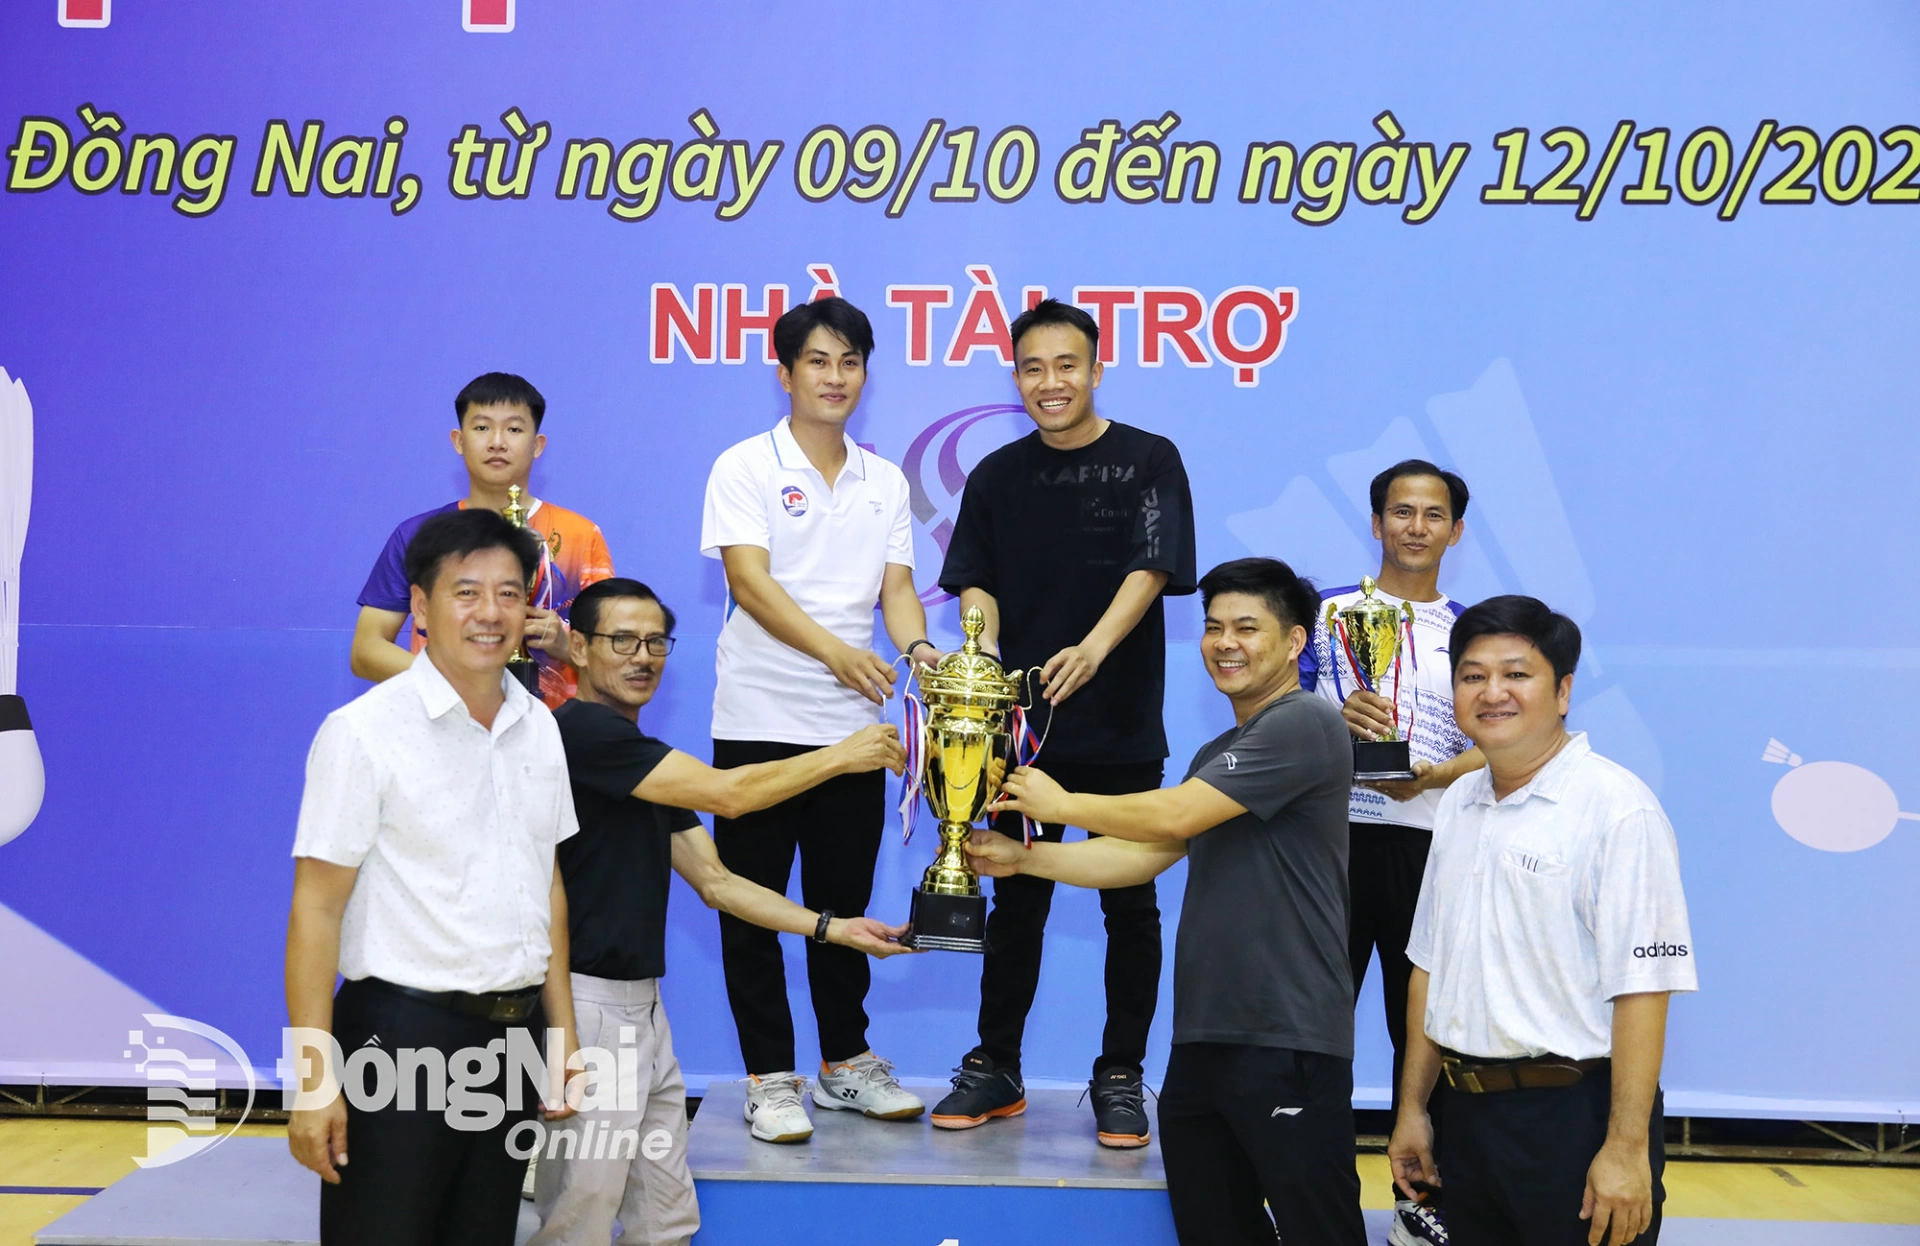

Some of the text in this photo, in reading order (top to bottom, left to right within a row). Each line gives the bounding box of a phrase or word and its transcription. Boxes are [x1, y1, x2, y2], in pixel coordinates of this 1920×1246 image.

[7, 103, 1920, 225] Đồng Nai, từ ngày 09/10 đến ngày 12/10/202
[887, 264, 1048, 366] TÀ
[1072, 285, 1298, 388] TRỢ
